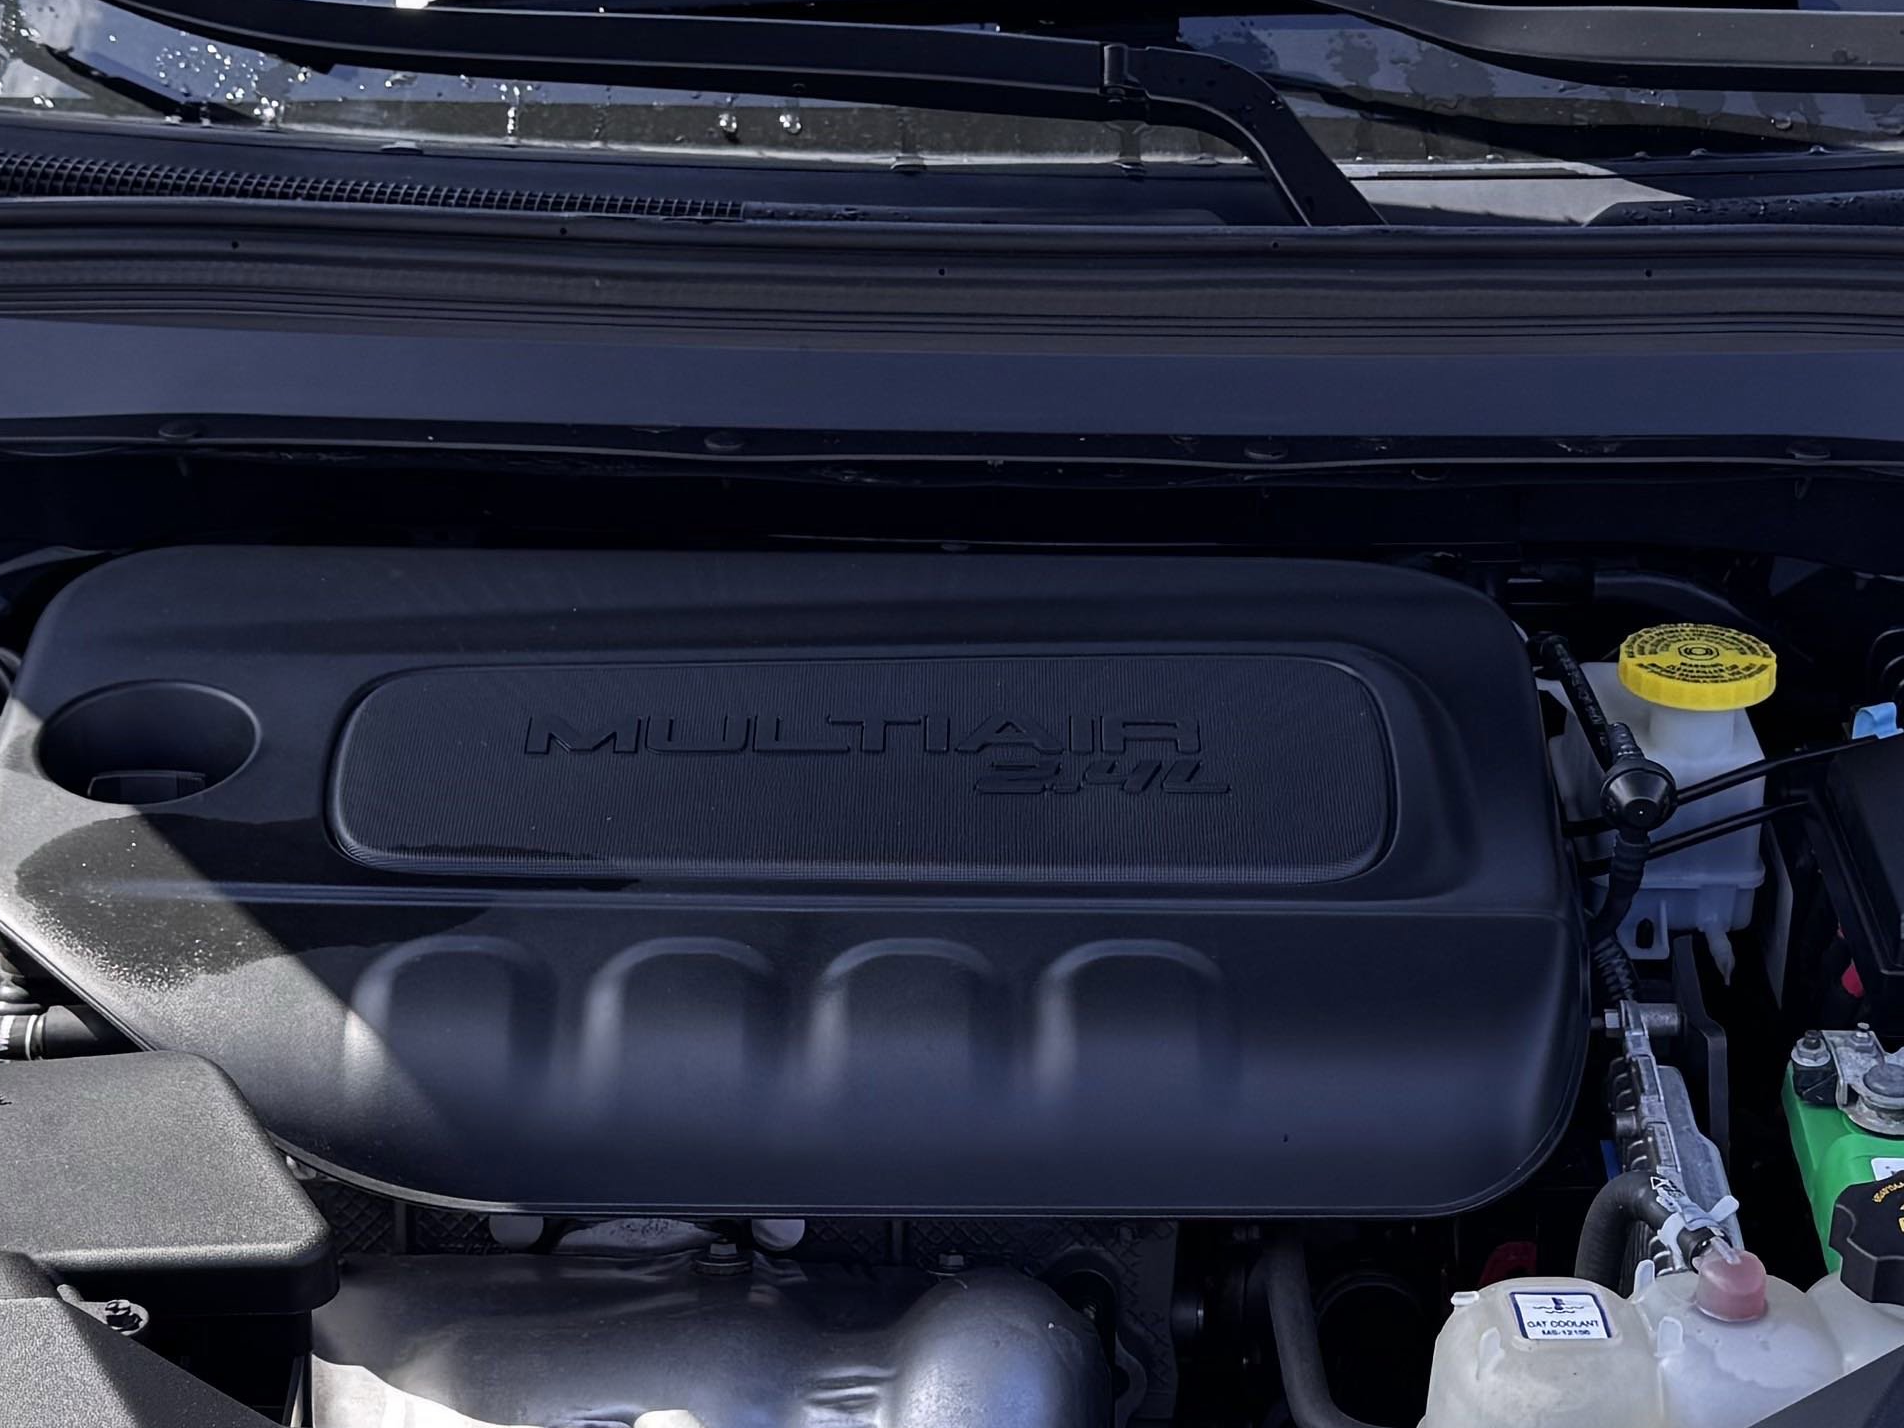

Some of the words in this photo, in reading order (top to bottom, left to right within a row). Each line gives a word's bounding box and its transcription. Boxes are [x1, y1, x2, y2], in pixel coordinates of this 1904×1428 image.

[524, 713, 1203, 756] MULTIAIR
[973, 760, 1234, 795] 2.4L
[1527, 1320, 1547, 1328] OAT
[1550, 1319, 1599, 1328] COOLANT
